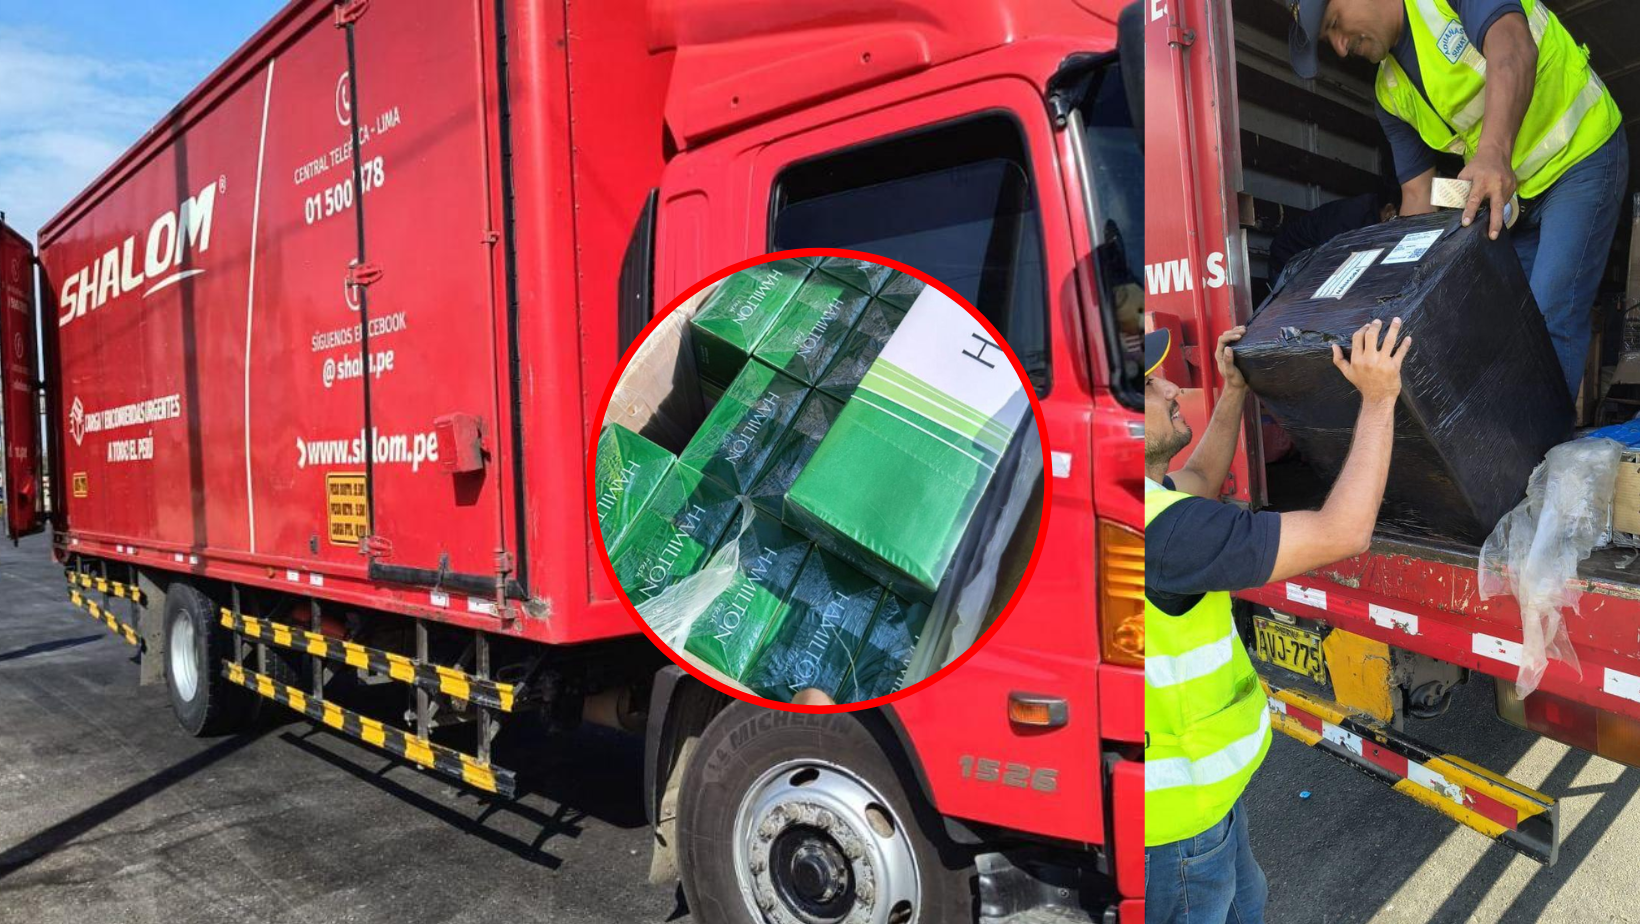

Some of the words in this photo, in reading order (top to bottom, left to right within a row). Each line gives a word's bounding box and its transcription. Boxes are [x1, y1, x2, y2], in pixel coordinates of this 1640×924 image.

[1452, 37, 1467, 58] SUNAT
[294, 154, 329, 185] CENTRAL
[376, 106, 400, 135] LIMA
[305, 192, 322, 225] 01
[325, 178, 353, 217] 500
[59, 181, 217, 327] SHALOM
[732, 268, 783, 326] HAMILTON
[797, 297, 844, 359] HAMILTON
[311, 327, 353, 353] SÍGUENOS
[368, 311, 407, 338] CEBOOK
[725, 391, 780, 466] HAMILTON
[639, 504, 706, 598] HAMILTON
[713, 546, 778, 645] HAMILTON
[788, 591, 850, 693] HAMILTON
[1259, 630, 1320, 673] AVJ-775
[959, 755, 1059, 793] 1526
